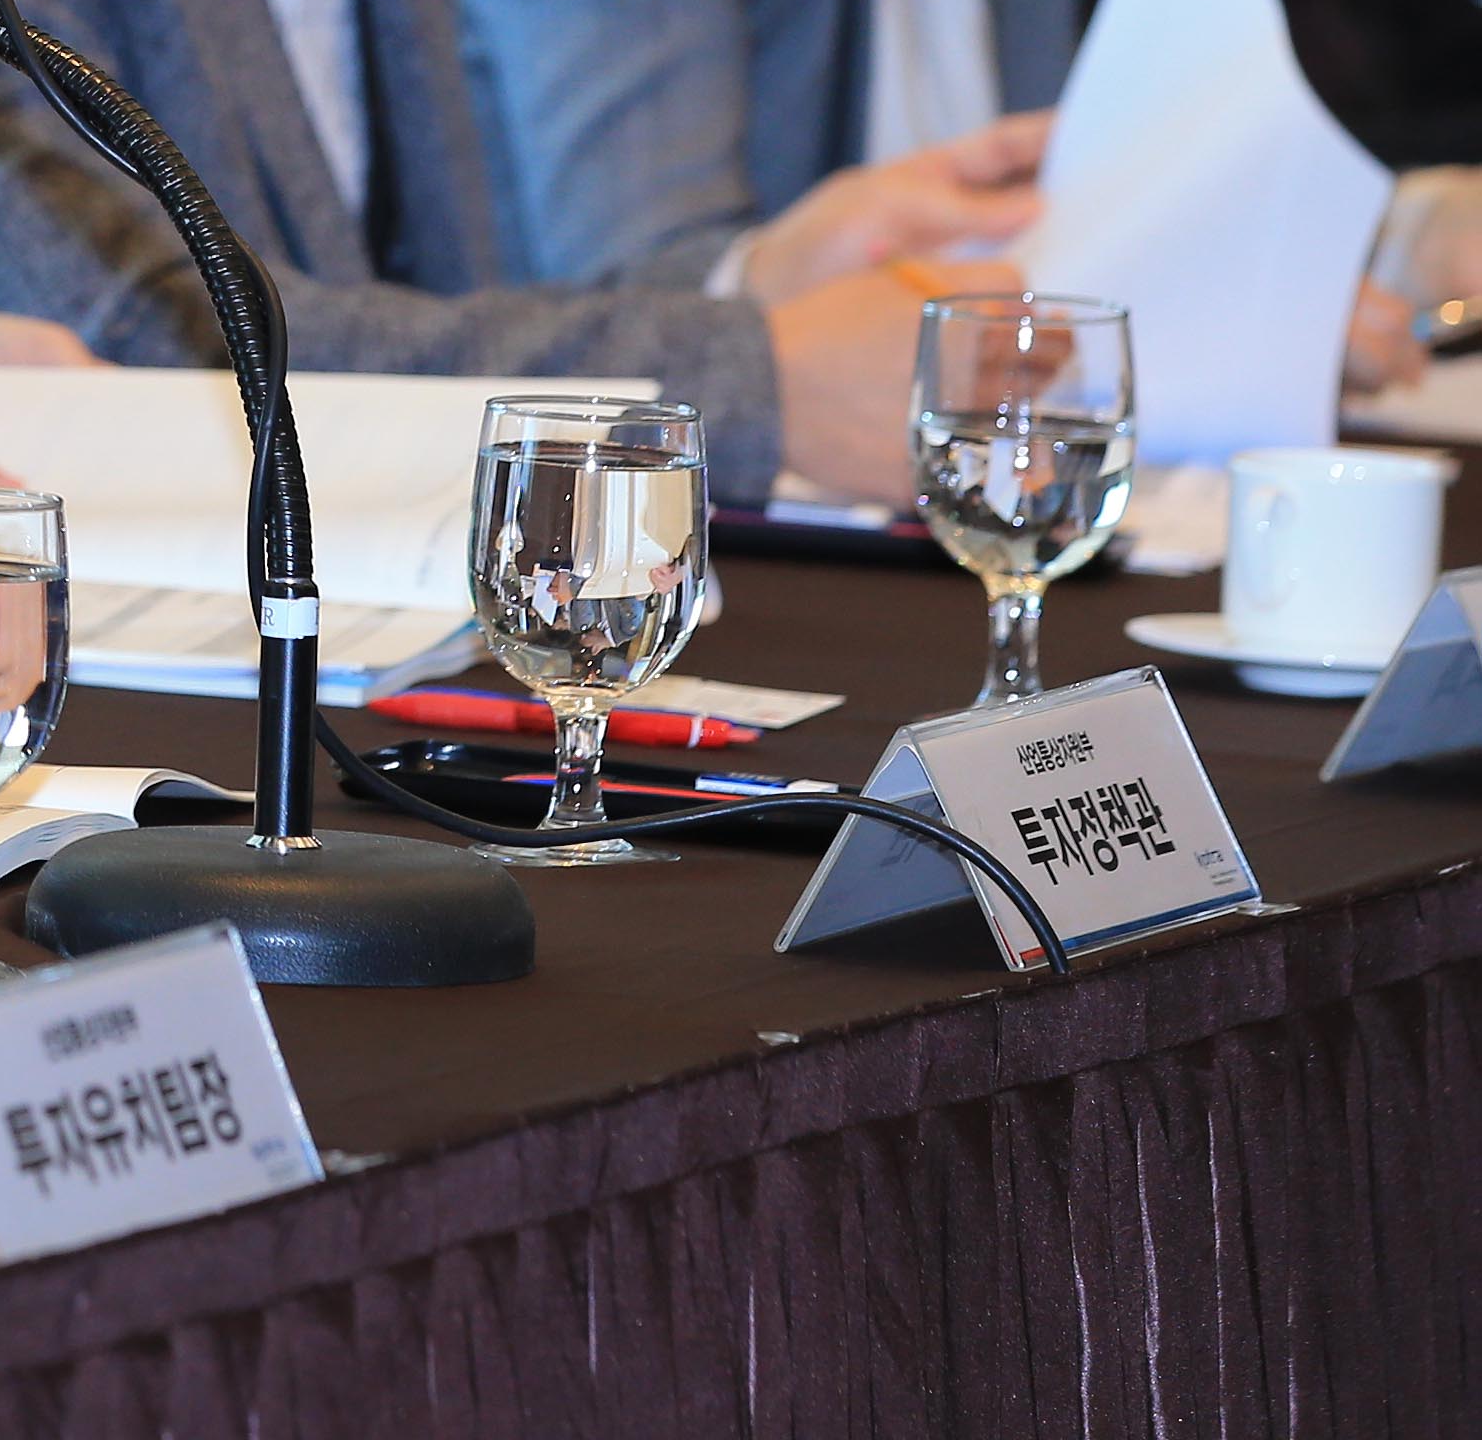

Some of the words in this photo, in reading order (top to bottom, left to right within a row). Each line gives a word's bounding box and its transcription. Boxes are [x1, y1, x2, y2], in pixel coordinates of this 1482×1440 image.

[1016, 729, 1094, 776] 산업통상자원부
[1010, 777, 1176, 886] 투자정책관
[3, 1051, 243, 1200] 투자유치팀장
